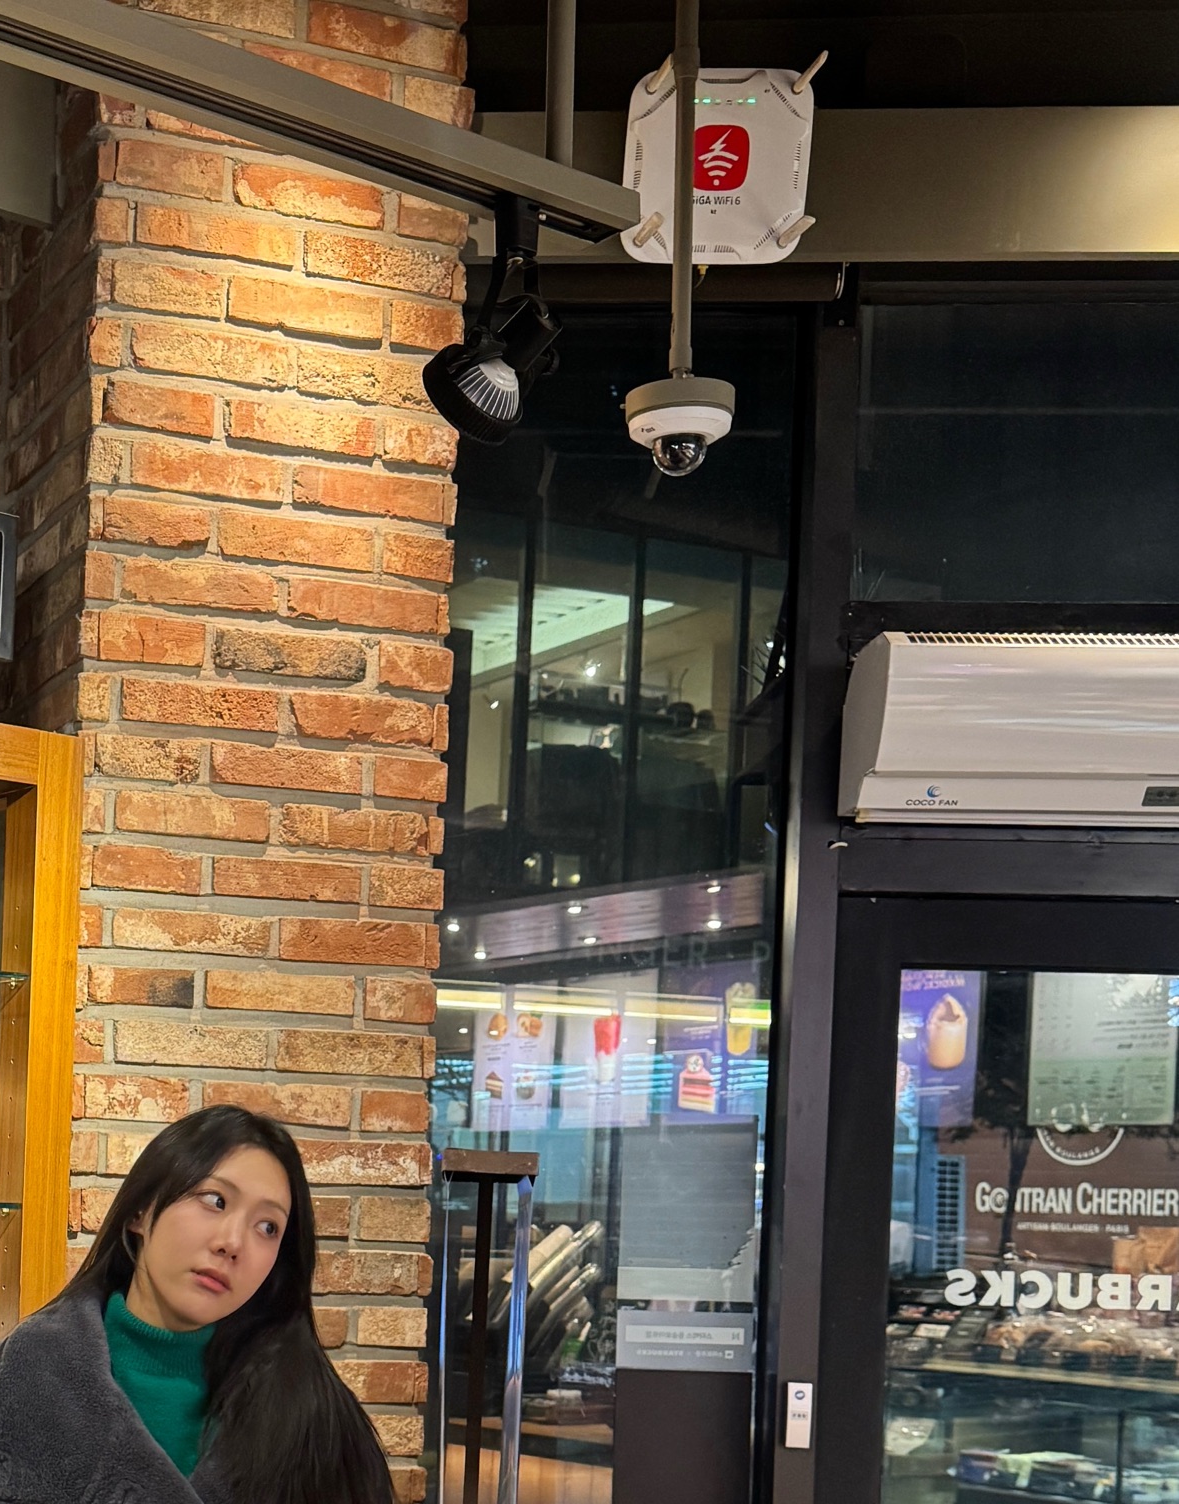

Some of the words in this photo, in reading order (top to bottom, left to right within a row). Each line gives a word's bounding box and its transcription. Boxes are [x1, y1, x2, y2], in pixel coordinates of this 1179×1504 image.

[714, 196, 733, 205] WiFi
[735, 196, 741, 205] 6
[905, 798, 936, 806] COCO
[938, 798, 959, 806] FAN
[1076, 1181, 1179, 1217] CHERRIER
